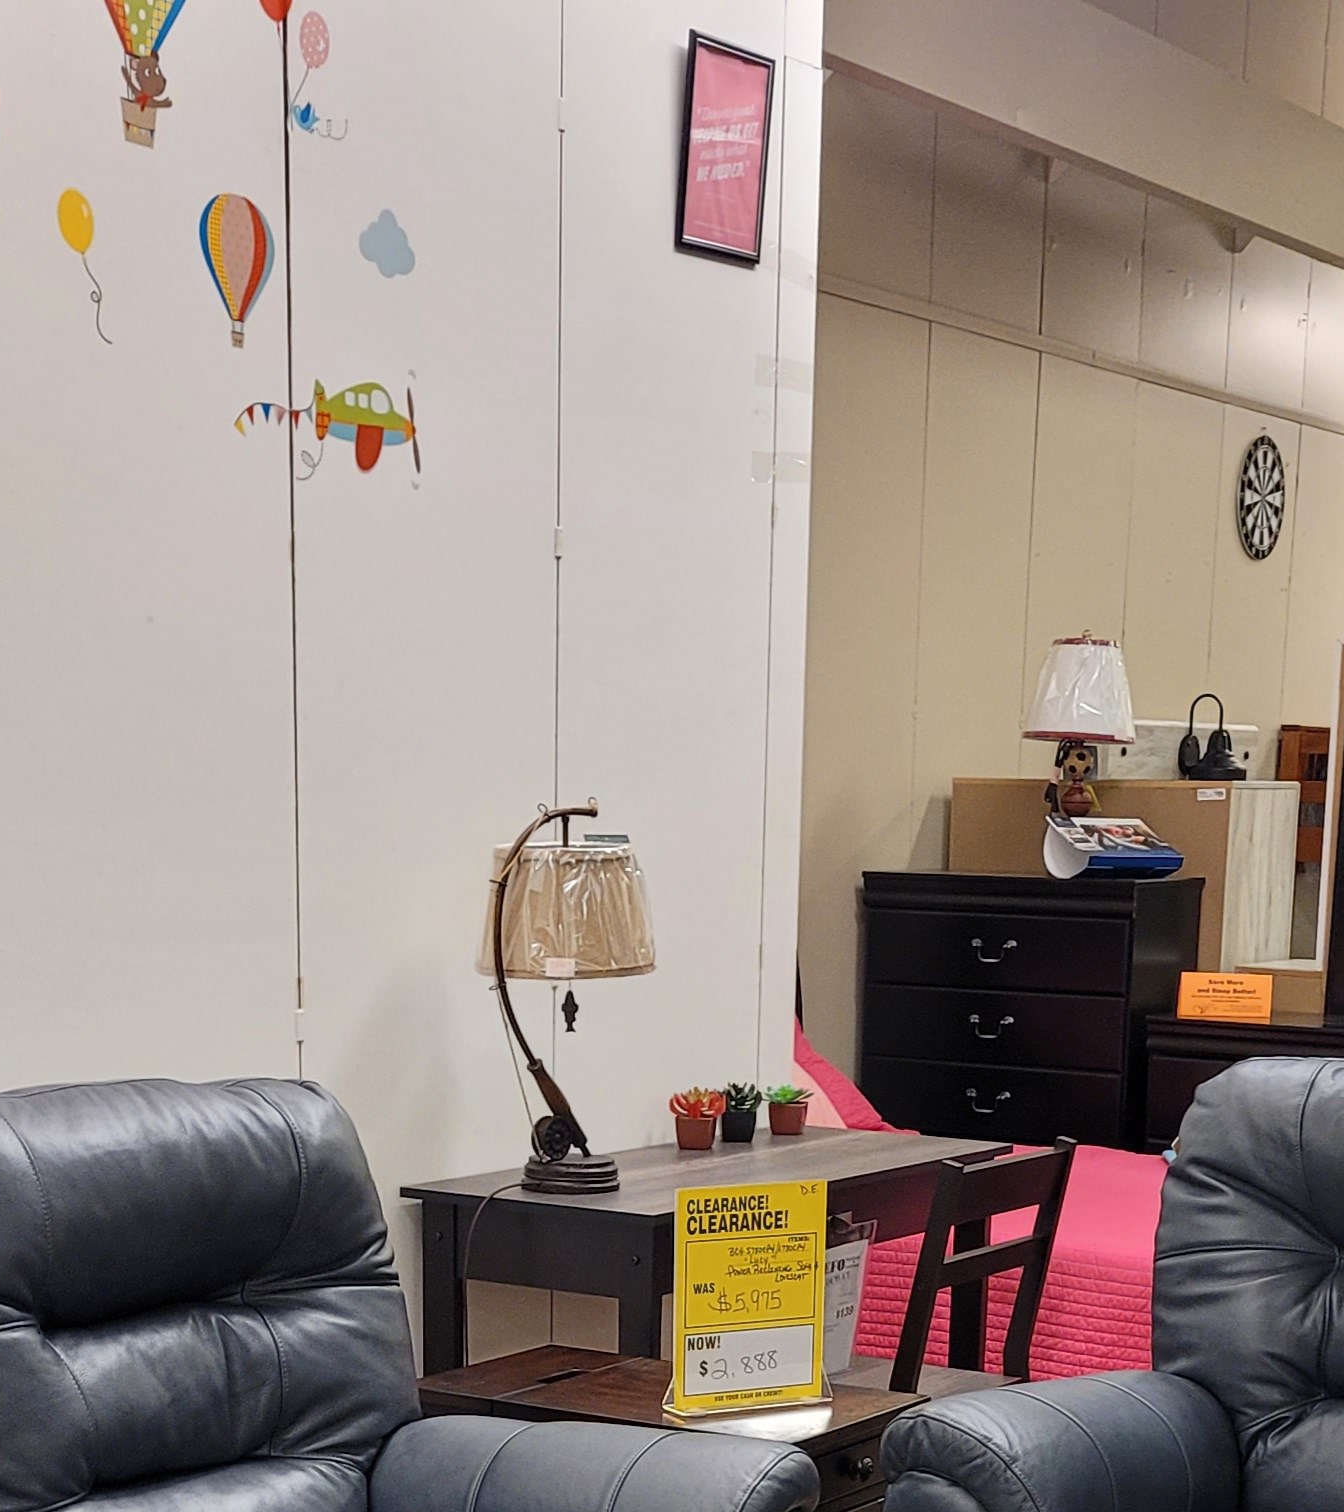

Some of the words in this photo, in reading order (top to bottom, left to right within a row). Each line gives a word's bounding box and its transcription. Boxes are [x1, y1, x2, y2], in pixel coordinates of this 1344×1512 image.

[687, 1195, 769, 1215] CLEARANCE!
[687, 1210, 789, 1236] CLEARANCE!
[693, 1282, 715, 1295] WAS
[687, 1335, 721, 1351] NOW!
